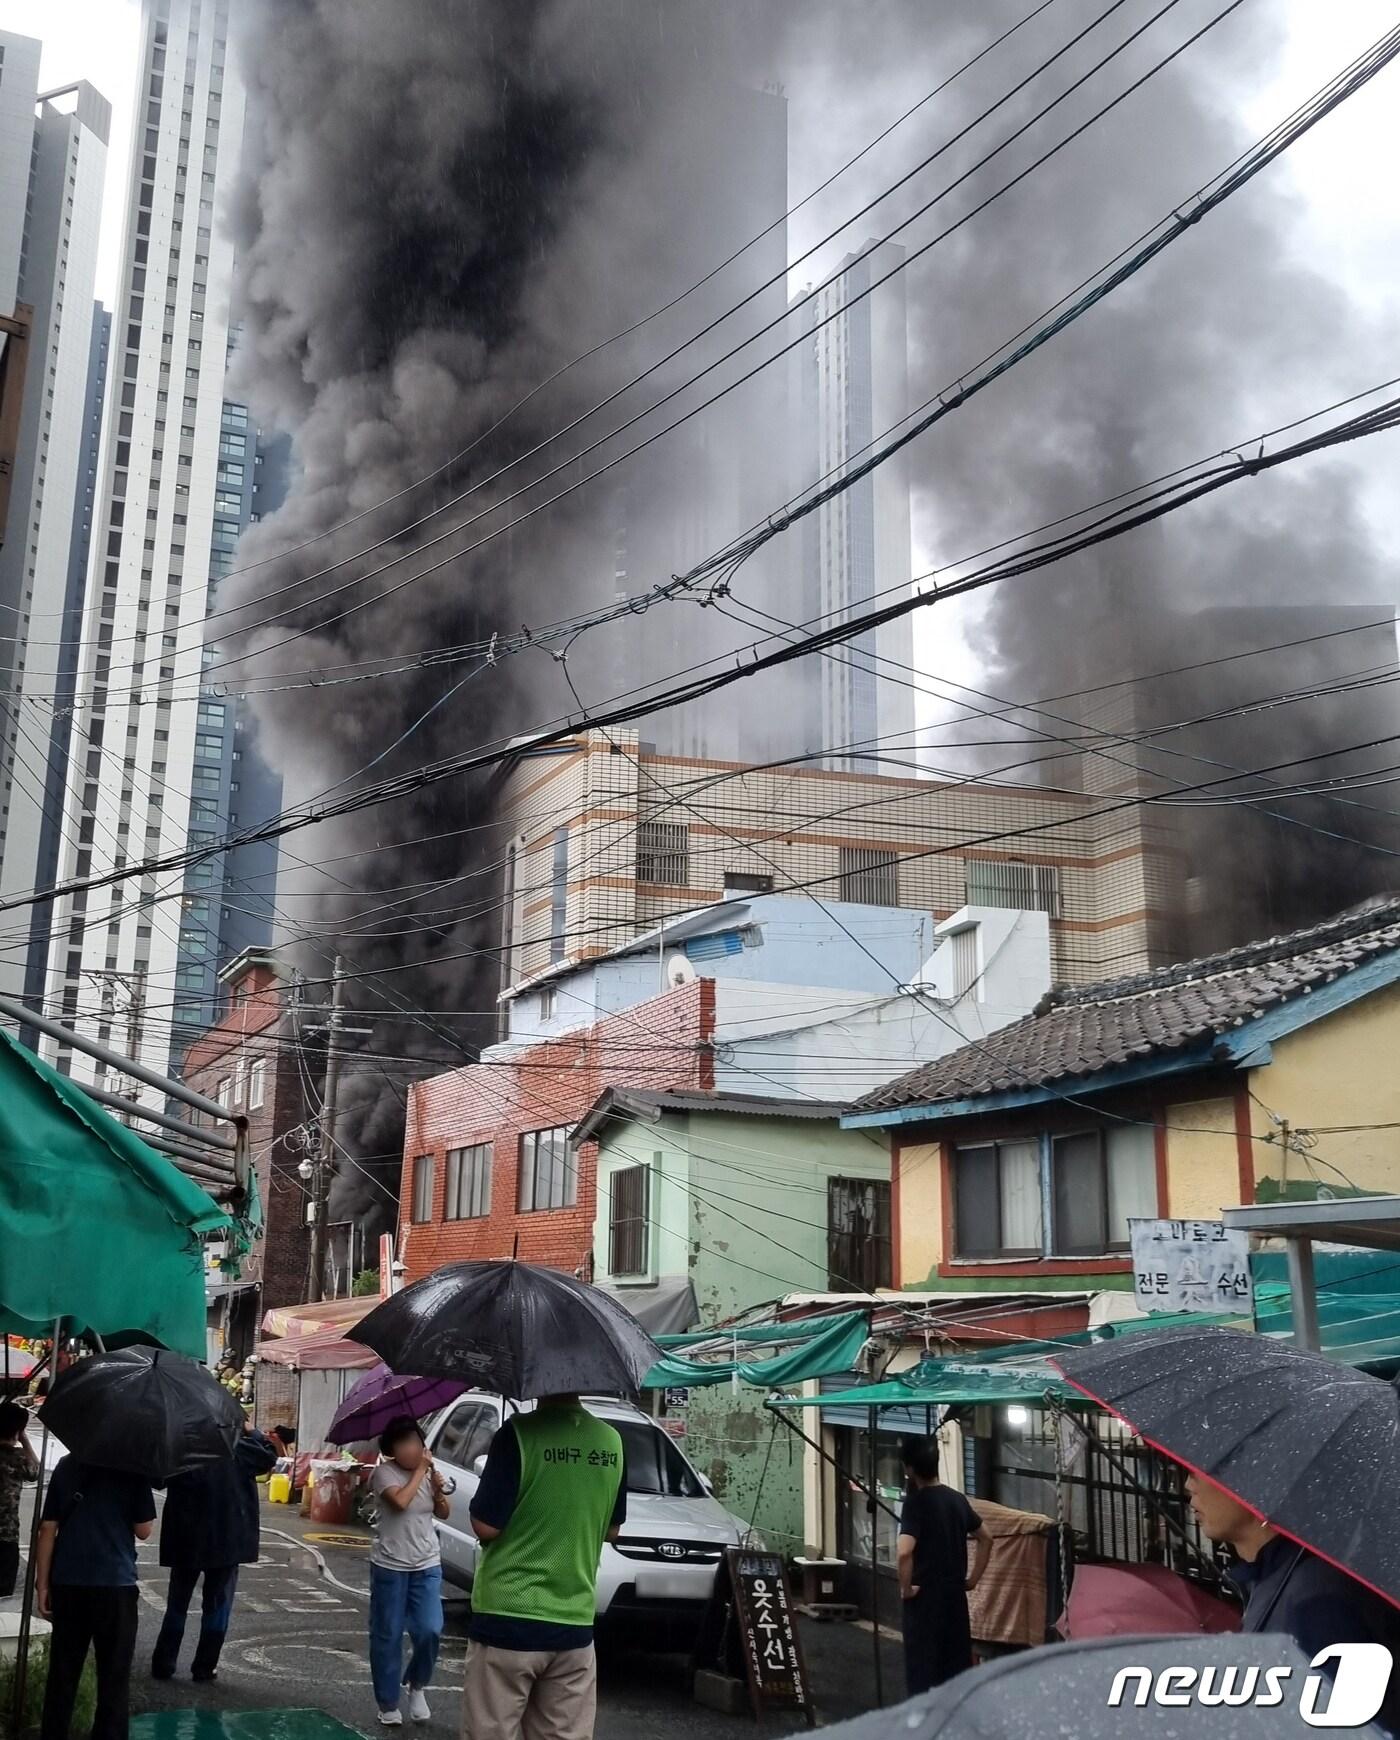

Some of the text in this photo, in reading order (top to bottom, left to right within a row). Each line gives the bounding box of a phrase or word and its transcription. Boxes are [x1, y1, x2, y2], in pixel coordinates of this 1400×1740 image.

[1138, 1272, 1170, 1295] 전문
[1217, 1272, 1249, 1296] 수선
[671, 1395, 684, 1405] 55
[544, 1446, 618, 1468] 이바구 순찰대
[662, 1545, 681, 1555] KIA
[752, 1578, 786, 1671] 옷수선
